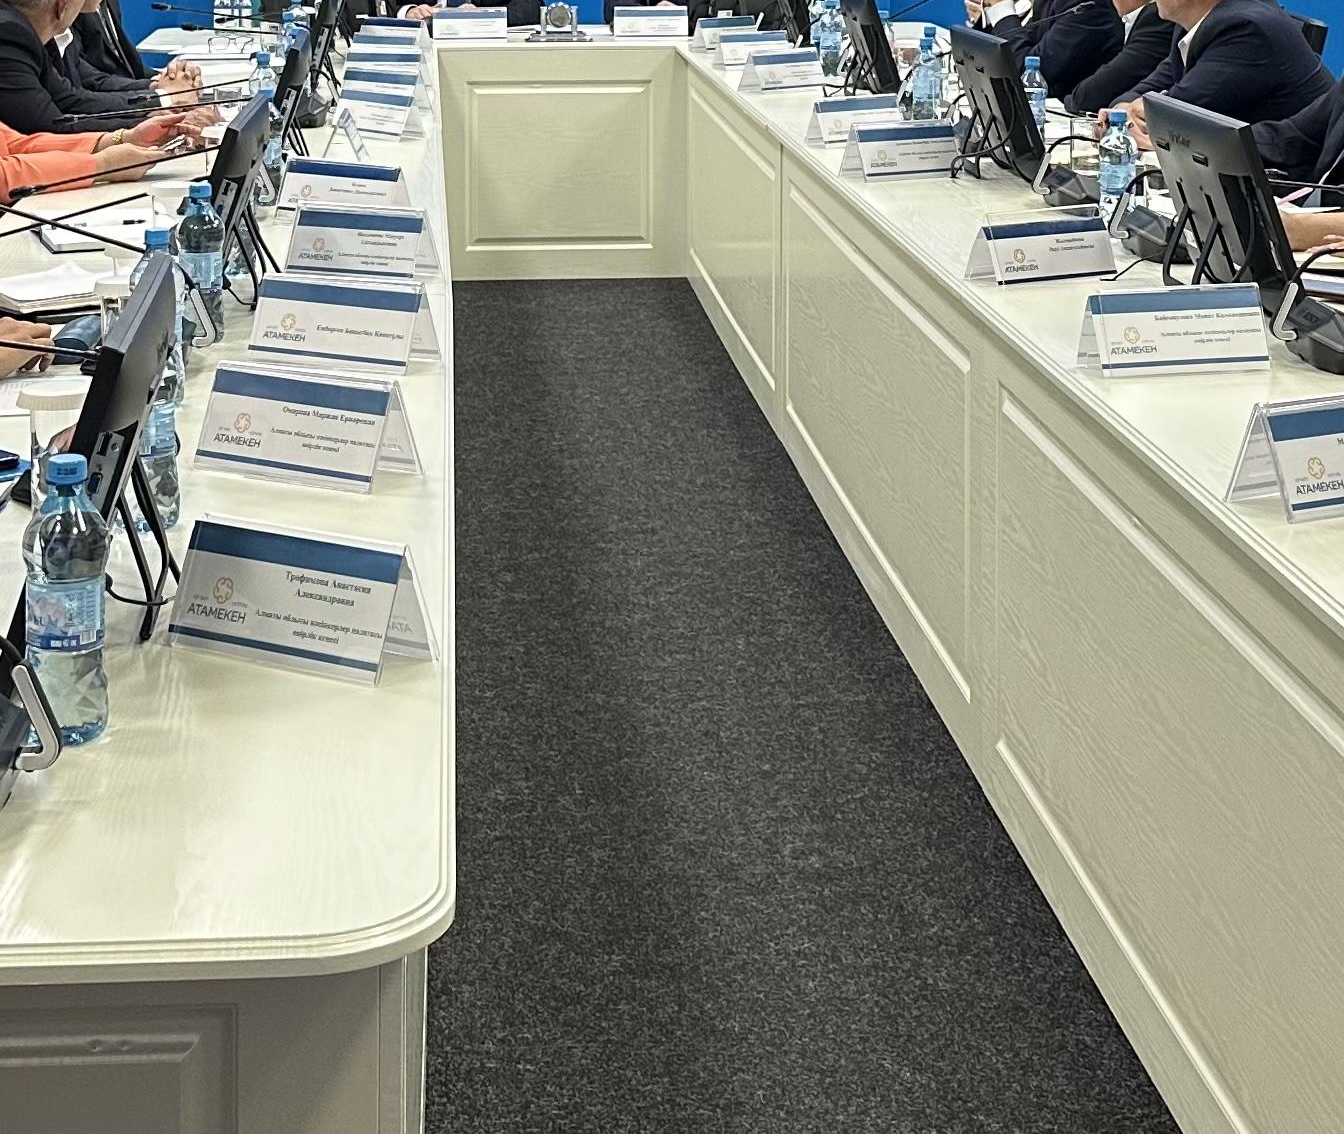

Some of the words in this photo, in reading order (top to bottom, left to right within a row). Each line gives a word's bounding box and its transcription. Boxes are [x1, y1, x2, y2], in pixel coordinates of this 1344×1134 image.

[262, 331, 306, 342] АТАМЕКЕН
[1111, 346, 1157, 355] АТАМЕКЕН
[213, 432, 261, 449] АТАМЕКЕН
[1296, 479, 1344, 496] АТАМЕКЕН
[187, 602, 246, 624] АТАМЕКЕН
